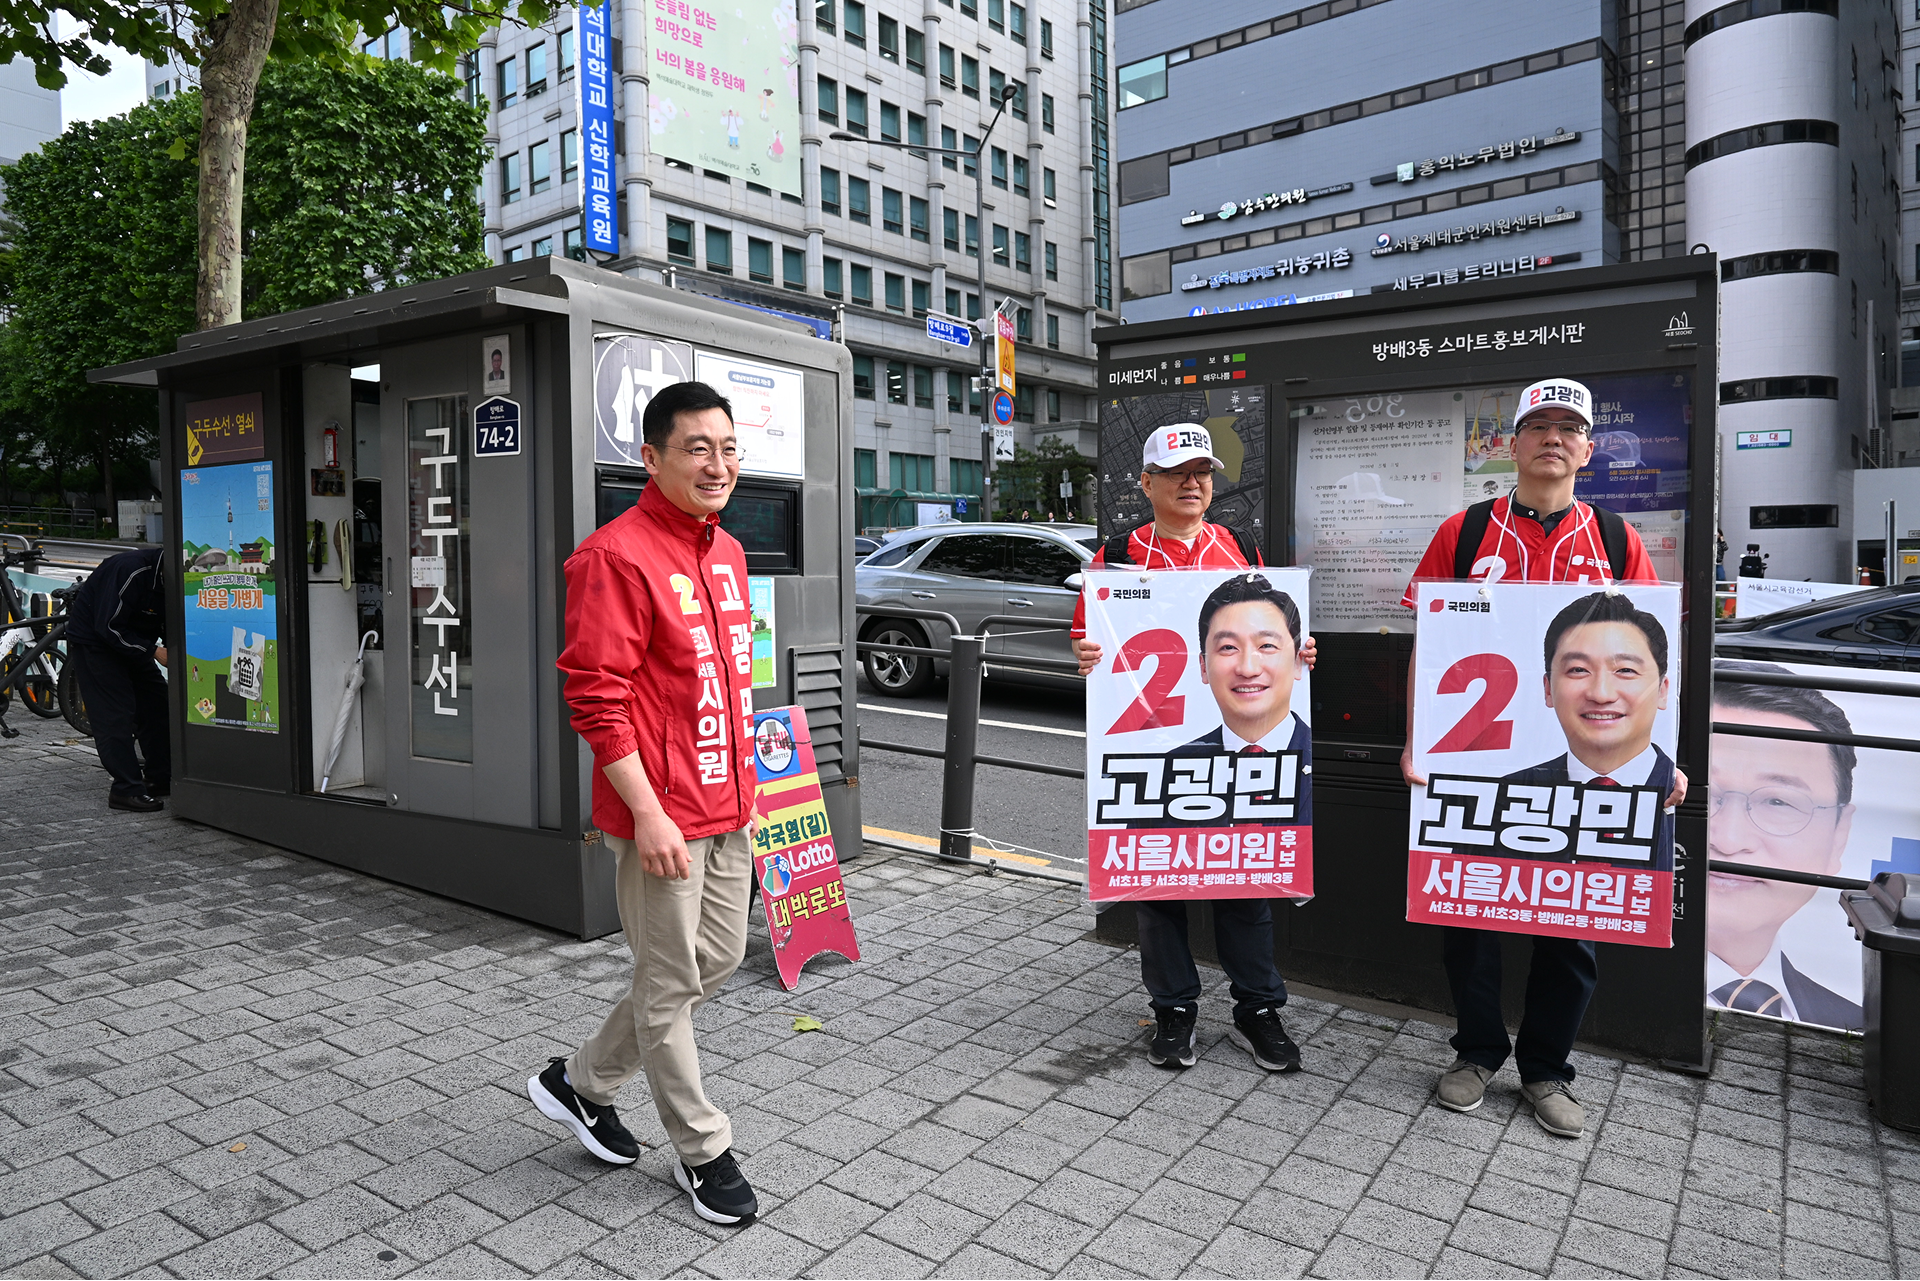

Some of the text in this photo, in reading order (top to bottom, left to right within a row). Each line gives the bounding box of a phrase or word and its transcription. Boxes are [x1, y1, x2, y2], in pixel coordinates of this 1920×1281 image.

[655, 16, 703, 48] 희망으로
[693, 8, 718, 31] 없는
[656, 48, 681, 69] 너의
[684, 57, 706, 81] 봄을
[709, 67, 746, 93] 응원해
[1419, 135, 1537, 177] 홍익노무법인
[588, 118, 612, 244] 신학교육원
[1240, 188, 1306, 215] 남수한의원
[1394, 211, 1544, 252] 서울제대군인지원센터
[1209, 246, 1350, 288] 전북특별자치도 귀농귀촌
[1393, 254, 1550, 291] 세무그룹 트리니티 2F
[1372, 322, 1585, 361] 방배3동 스마트홍보게시판
[1109, 367, 1157, 385] 미세먼지
[490, 405, 504, 415] 방배로
[1397, 420, 1424, 430] 확인기간
[1437, 418, 1451, 428] 공고
[1600, 402, 1623, 413] 행사,
[1613, 413, 1634, 424] 시작
[480, 425, 514, 448] 74-2
[995, 428, 1013, 437] 견인지역
[420, 427, 460, 716] 구두수선
[1587, 558, 1610, 570] 국민의
[196, 588, 264, 609] 서울을 가볍게
[670, 573, 702, 615] 2
[1113, 589, 1151, 600] 국민의힘
[1448, 601, 1490, 613] 국민의힘
[1748, 584, 1812, 596] 서울시교육감선거
[711, 564, 754, 739] 고광민
[1105, 628, 1188, 735] 2
[1426, 653, 1518, 754] 2
[697, 678, 728, 785] 시의원
[763, 753, 790, 762] CIGARETTES
[1097, 753, 1299, 823] 고광민
[754, 811, 828, 851] 약국옆(길)
[1418, 776, 1660, 863] 고광민
[789, 842, 834, 874] Lotto
[1101, 830, 1297, 871] 서울시의원 후보
[770, 879, 847, 929] 대박로또
[1422, 859, 1653, 916] 서울시의원 후보
